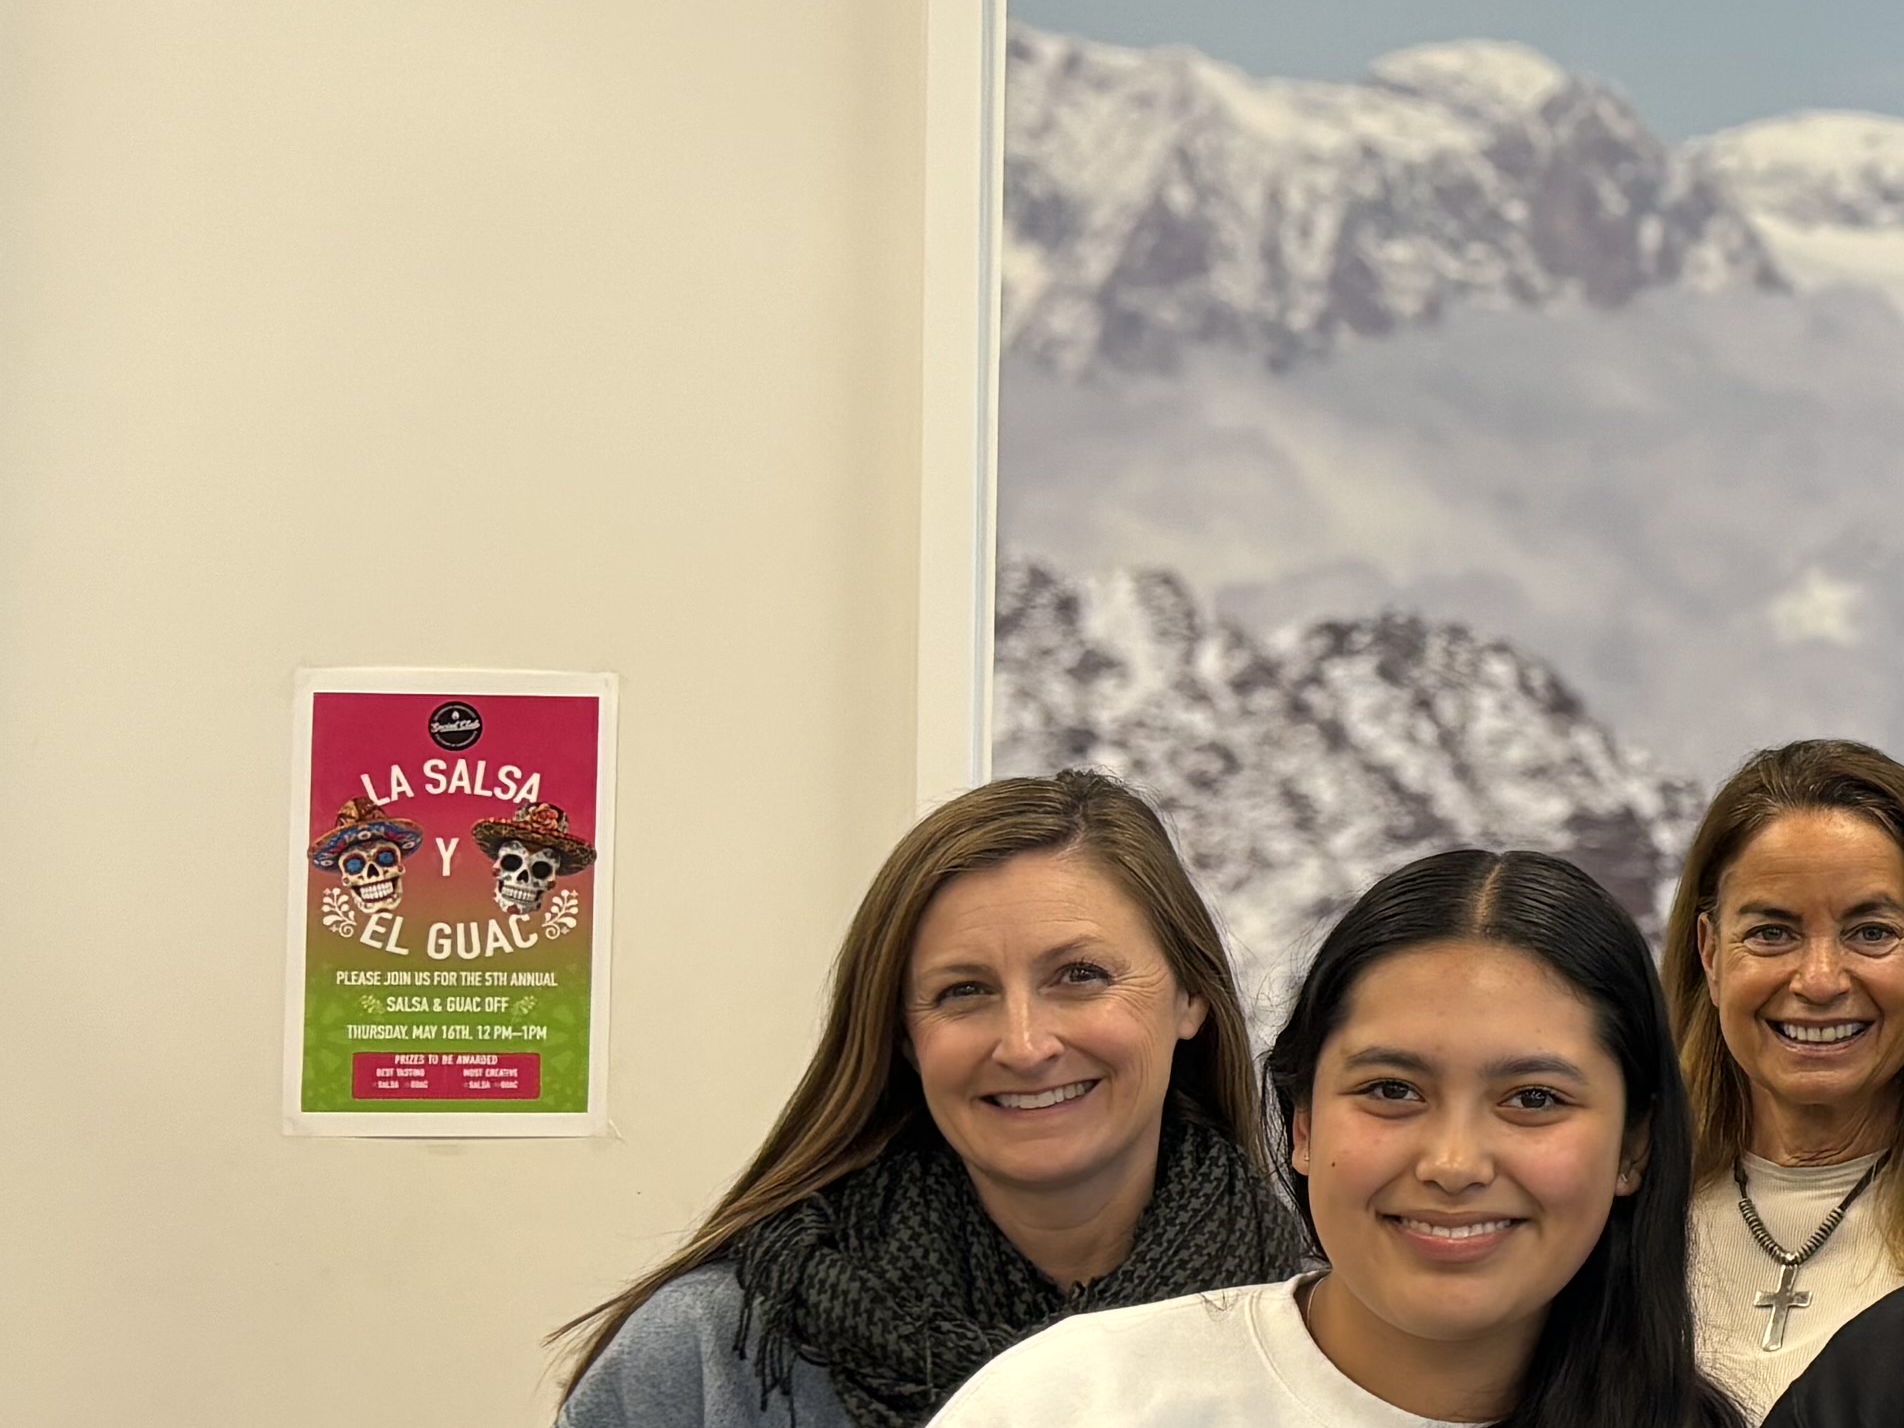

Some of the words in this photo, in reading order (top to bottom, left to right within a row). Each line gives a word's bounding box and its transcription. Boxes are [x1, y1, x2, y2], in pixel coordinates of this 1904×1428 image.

[360, 764, 415, 806] LA
[423, 758, 541, 804] SALSA
[435, 837, 460, 877] Y
[359, 912, 410, 956] EL
[427, 914, 539, 960] GUAC
[336, 971, 381, 985] PLEASE
[384, 971, 411, 985] JOIN
[414, 972, 431, 985] US
[433, 972, 457, 986] FOR
[460, 972, 482, 986] THE
[485, 972, 508, 986] 5TH
[510, 972, 558, 987] ANNUAL
[386, 997, 429, 1012] SALSA
[433, 998, 442, 1012] &
[447, 997, 481, 1012] GUAC
[485, 997, 509, 1012] OFF
[412, 1025, 437, 1039] MAY
[477, 1026, 490, 1040] 12
[428, 1054, 438, 1065] TO
[442, 1054, 453, 1065] BE
